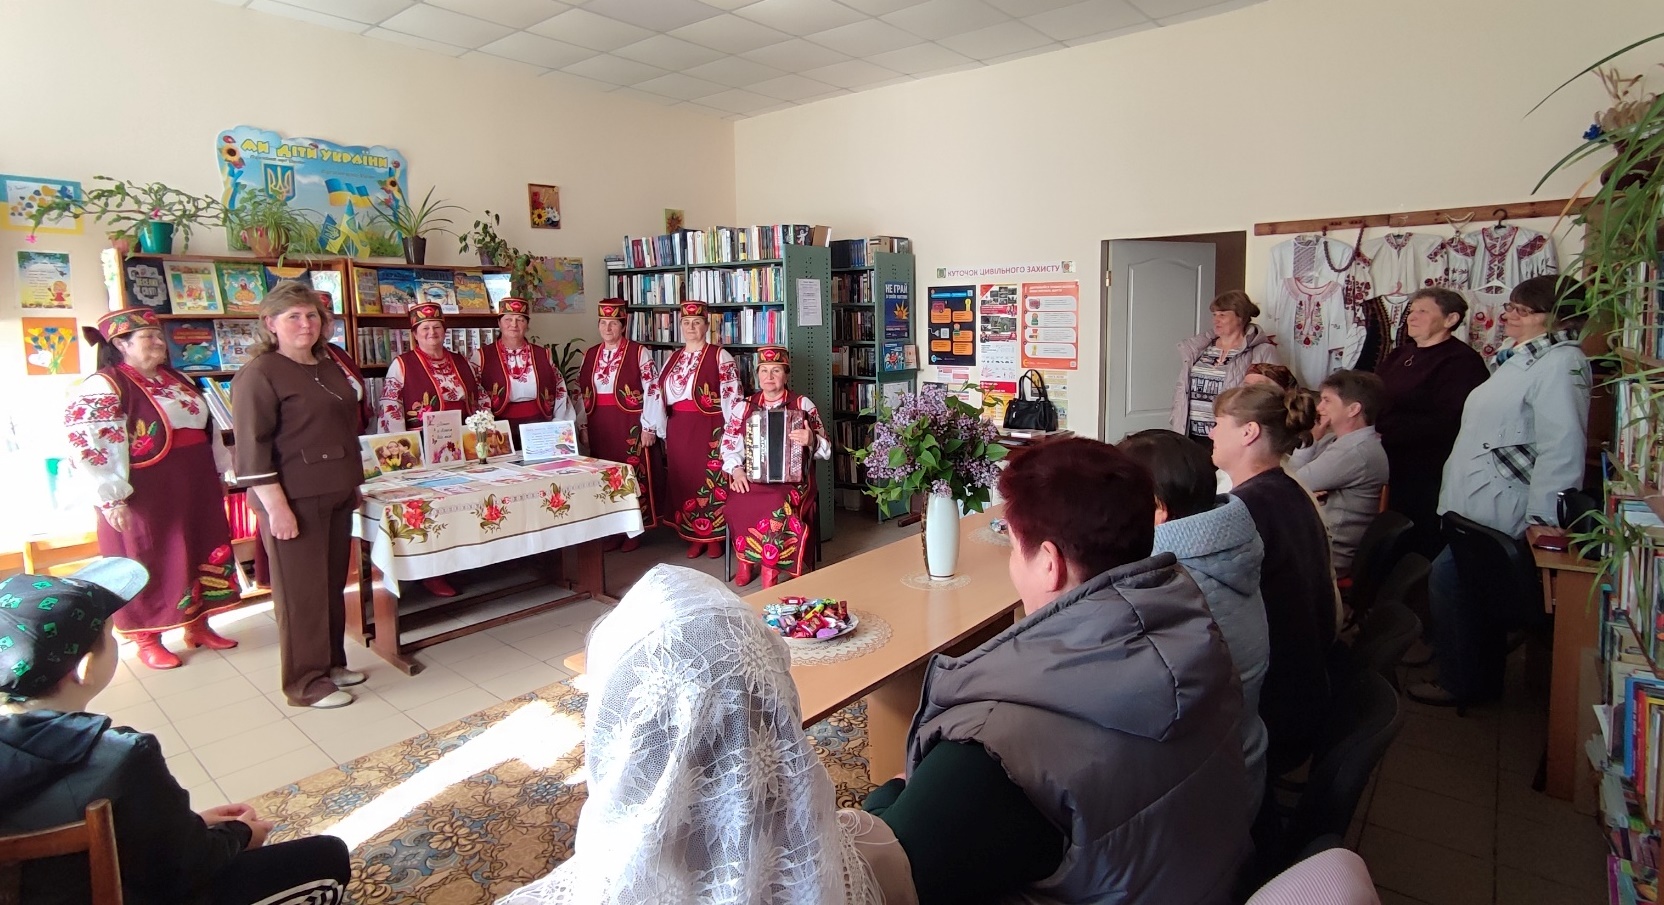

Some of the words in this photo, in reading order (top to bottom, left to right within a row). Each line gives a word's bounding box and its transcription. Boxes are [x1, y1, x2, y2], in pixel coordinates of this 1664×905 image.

[276, 144, 318, 159] ДІТИ
[320, 149, 388, 168] УКРАЇНИ
[979, 267, 1026, 276] ЦИВІЛЬНОГО
[1026, 264, 1060, 273] ЗАХИСТУ
[885, 283, 893, 293] НЕ
[893, 283, 908, 294] ГРАЙ
